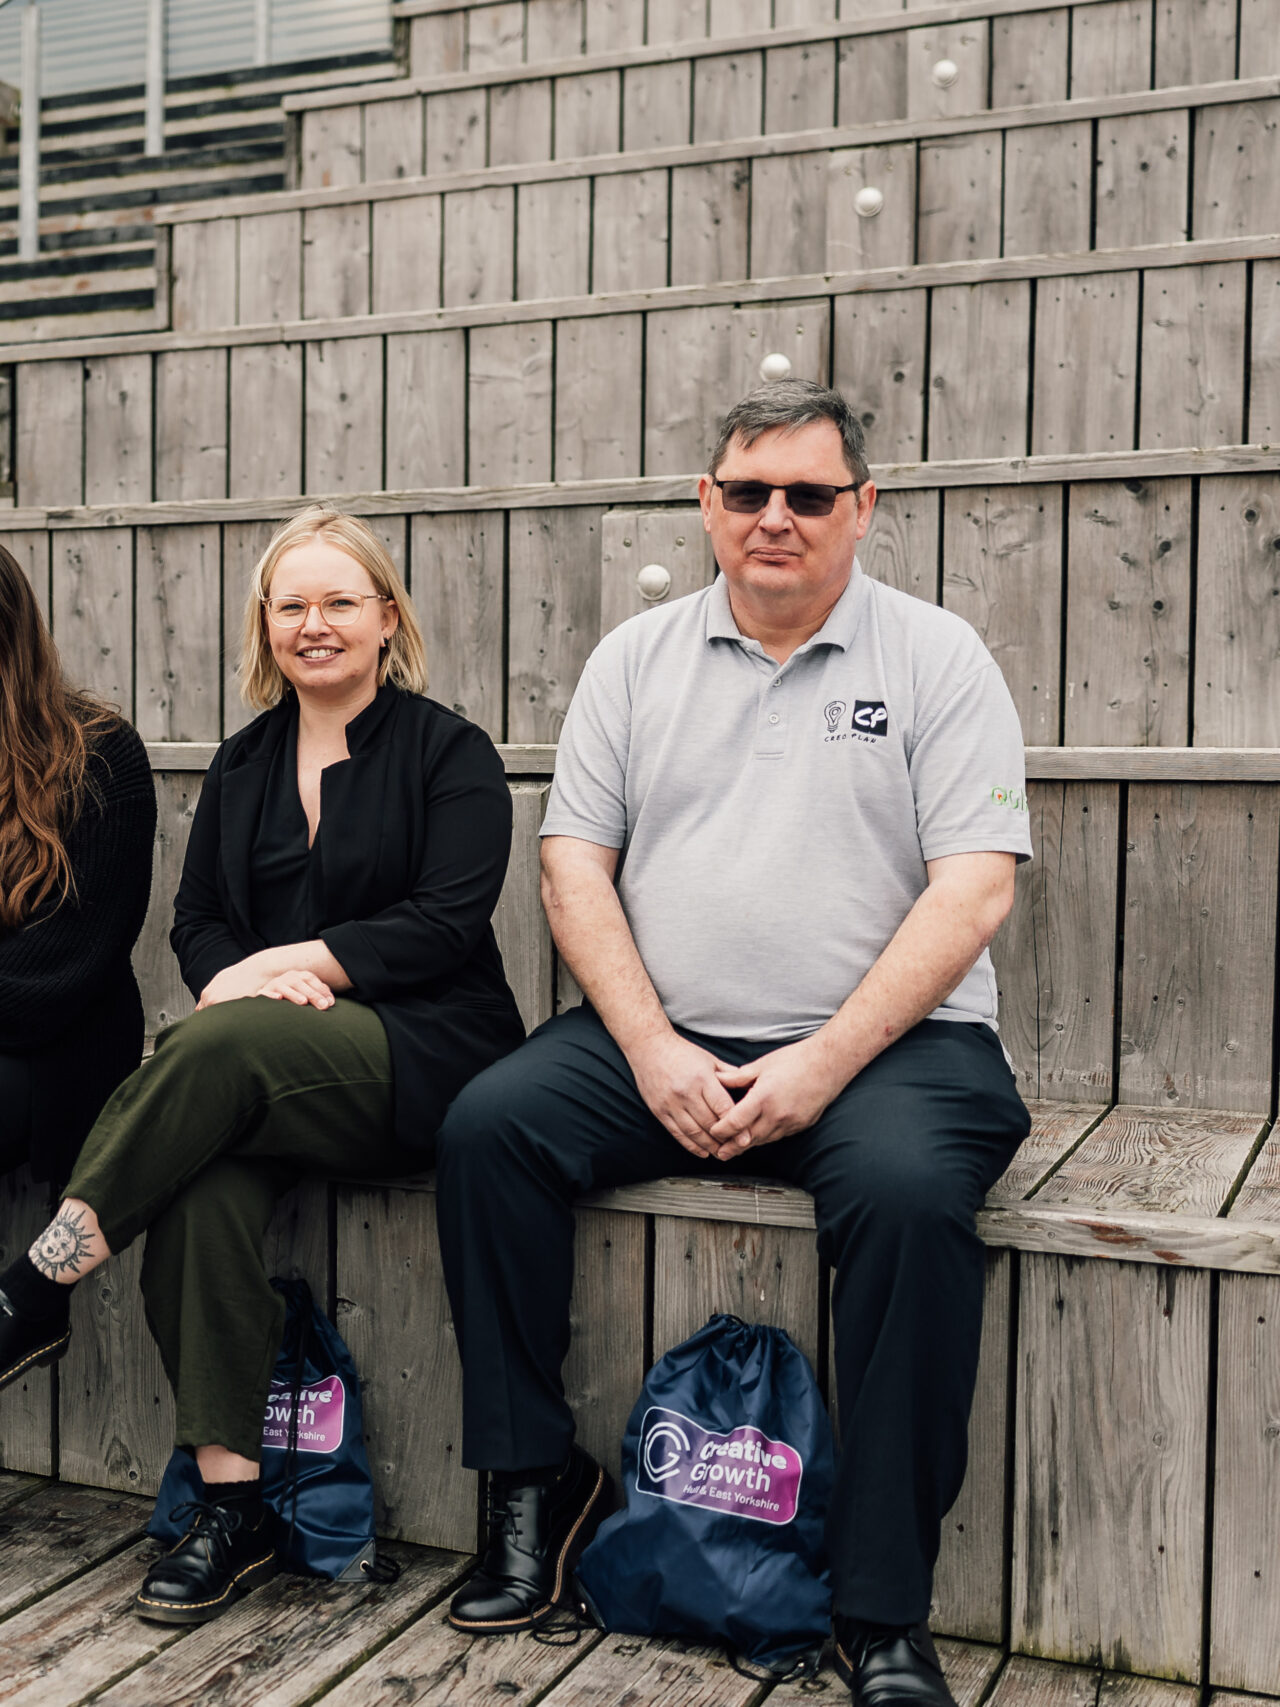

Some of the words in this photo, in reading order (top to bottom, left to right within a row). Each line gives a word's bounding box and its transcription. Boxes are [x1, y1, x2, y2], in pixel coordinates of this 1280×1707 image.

[263, 1426, 283, 1437] East
[699, 1439, 787, 1470] Creative
[690, 1463, 771, 1492] Growth
[682, 1485, 699, 1495] Hull
[699, 1485, 707, 1495] &
[709, 1486, 732, 1501] East
[734, 1492, 780, 1512] Yorkshire
